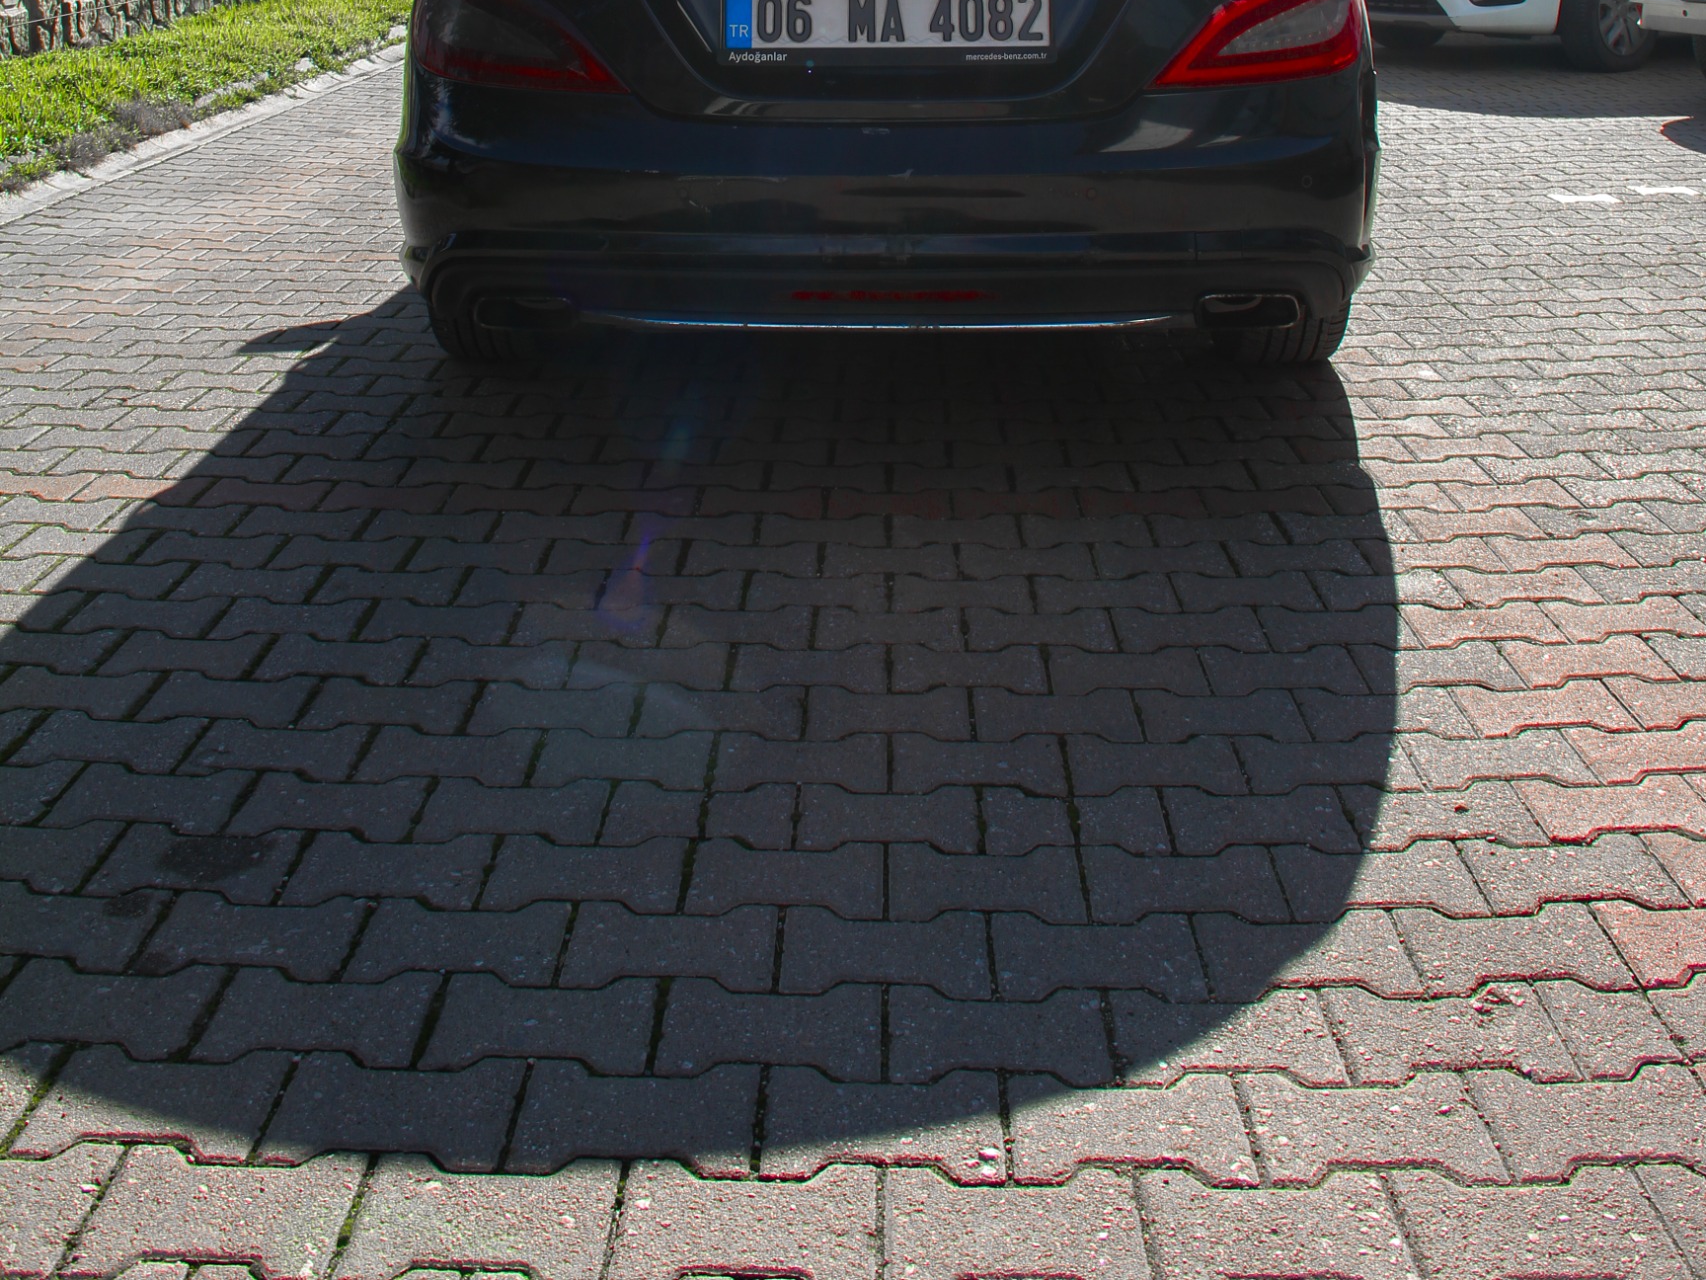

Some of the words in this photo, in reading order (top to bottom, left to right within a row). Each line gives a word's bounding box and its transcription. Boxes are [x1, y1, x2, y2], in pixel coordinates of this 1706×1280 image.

[729, 24, 749, 38] TR
[728, 51, 788, 63] Aydoğanlar
[965, 52, 1048, 61] mercedes-benz.com.tr
